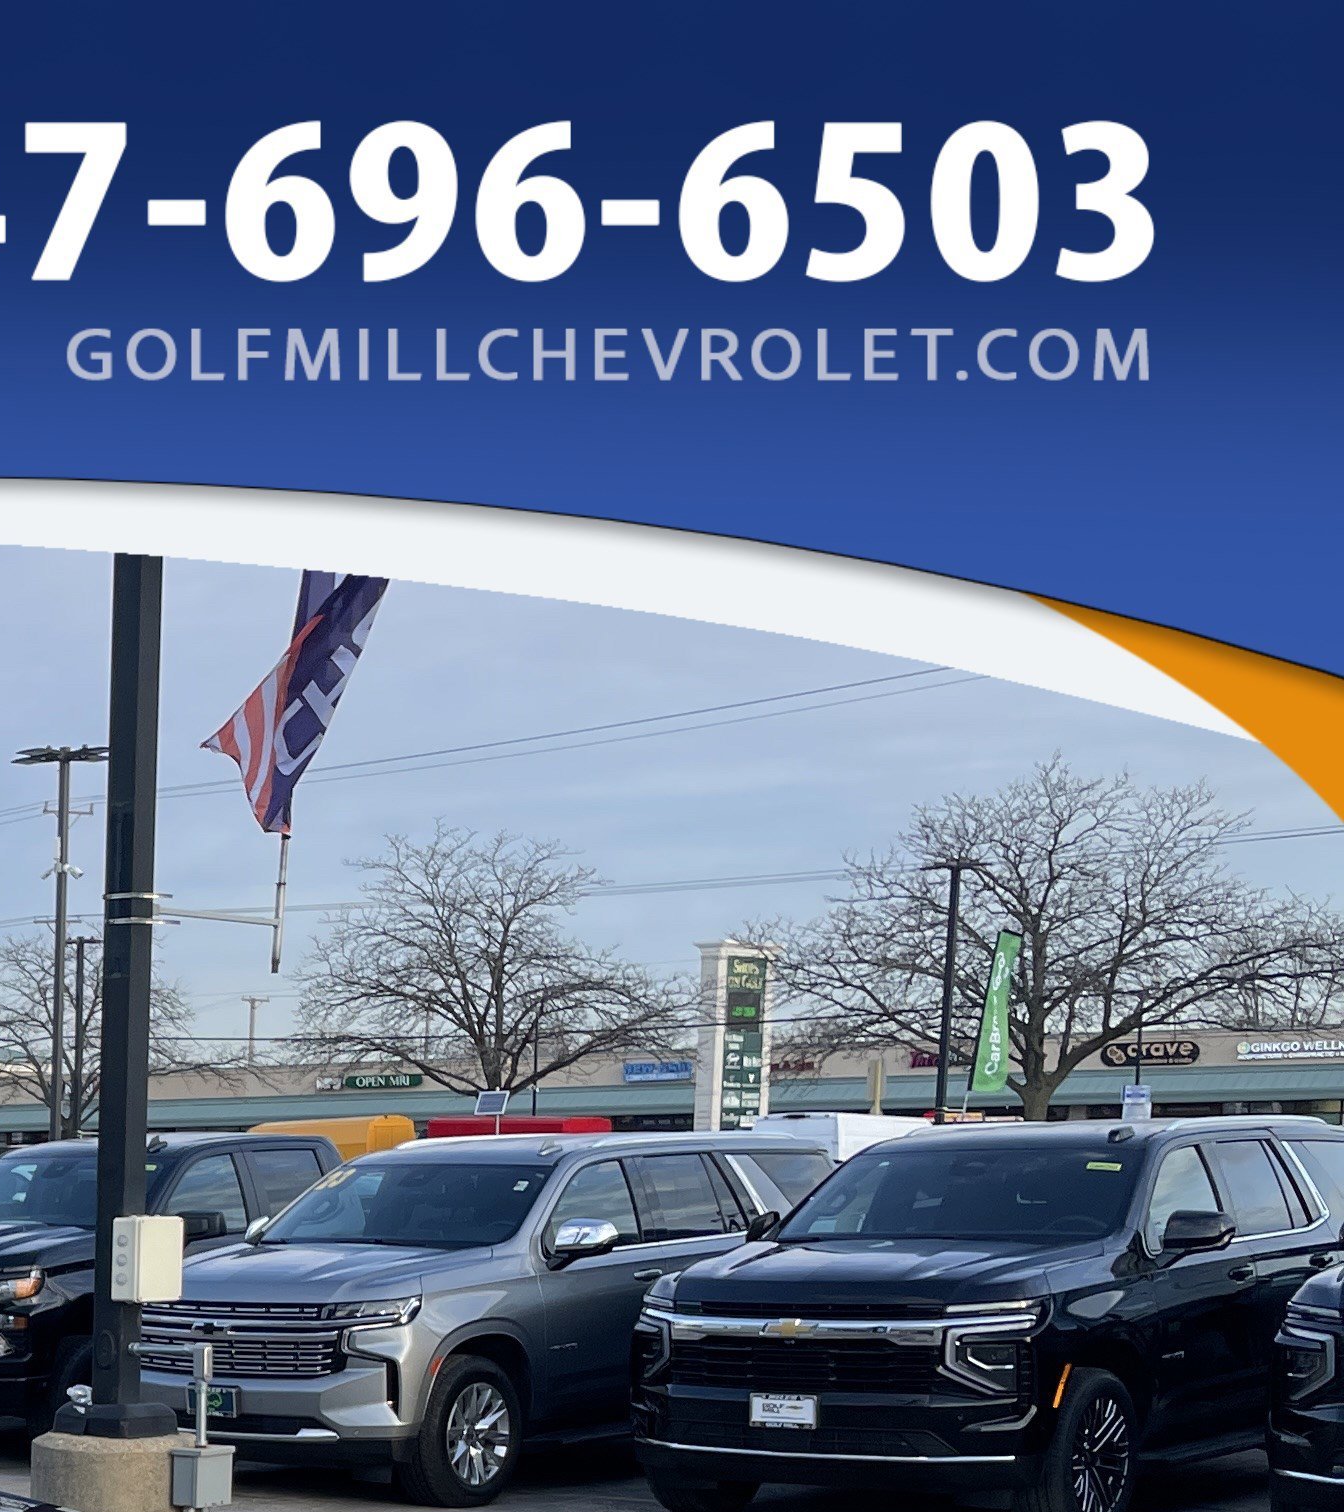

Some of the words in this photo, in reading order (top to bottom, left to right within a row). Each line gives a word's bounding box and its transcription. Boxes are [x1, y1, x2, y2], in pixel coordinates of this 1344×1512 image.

[1126, 1042, 1194, 1057] crave
[1250, 1041, 1301, 1053] GINKGO
[355, 1076, 386, 1088] OPEN
[389, 1075, 410, 1086] MRI
